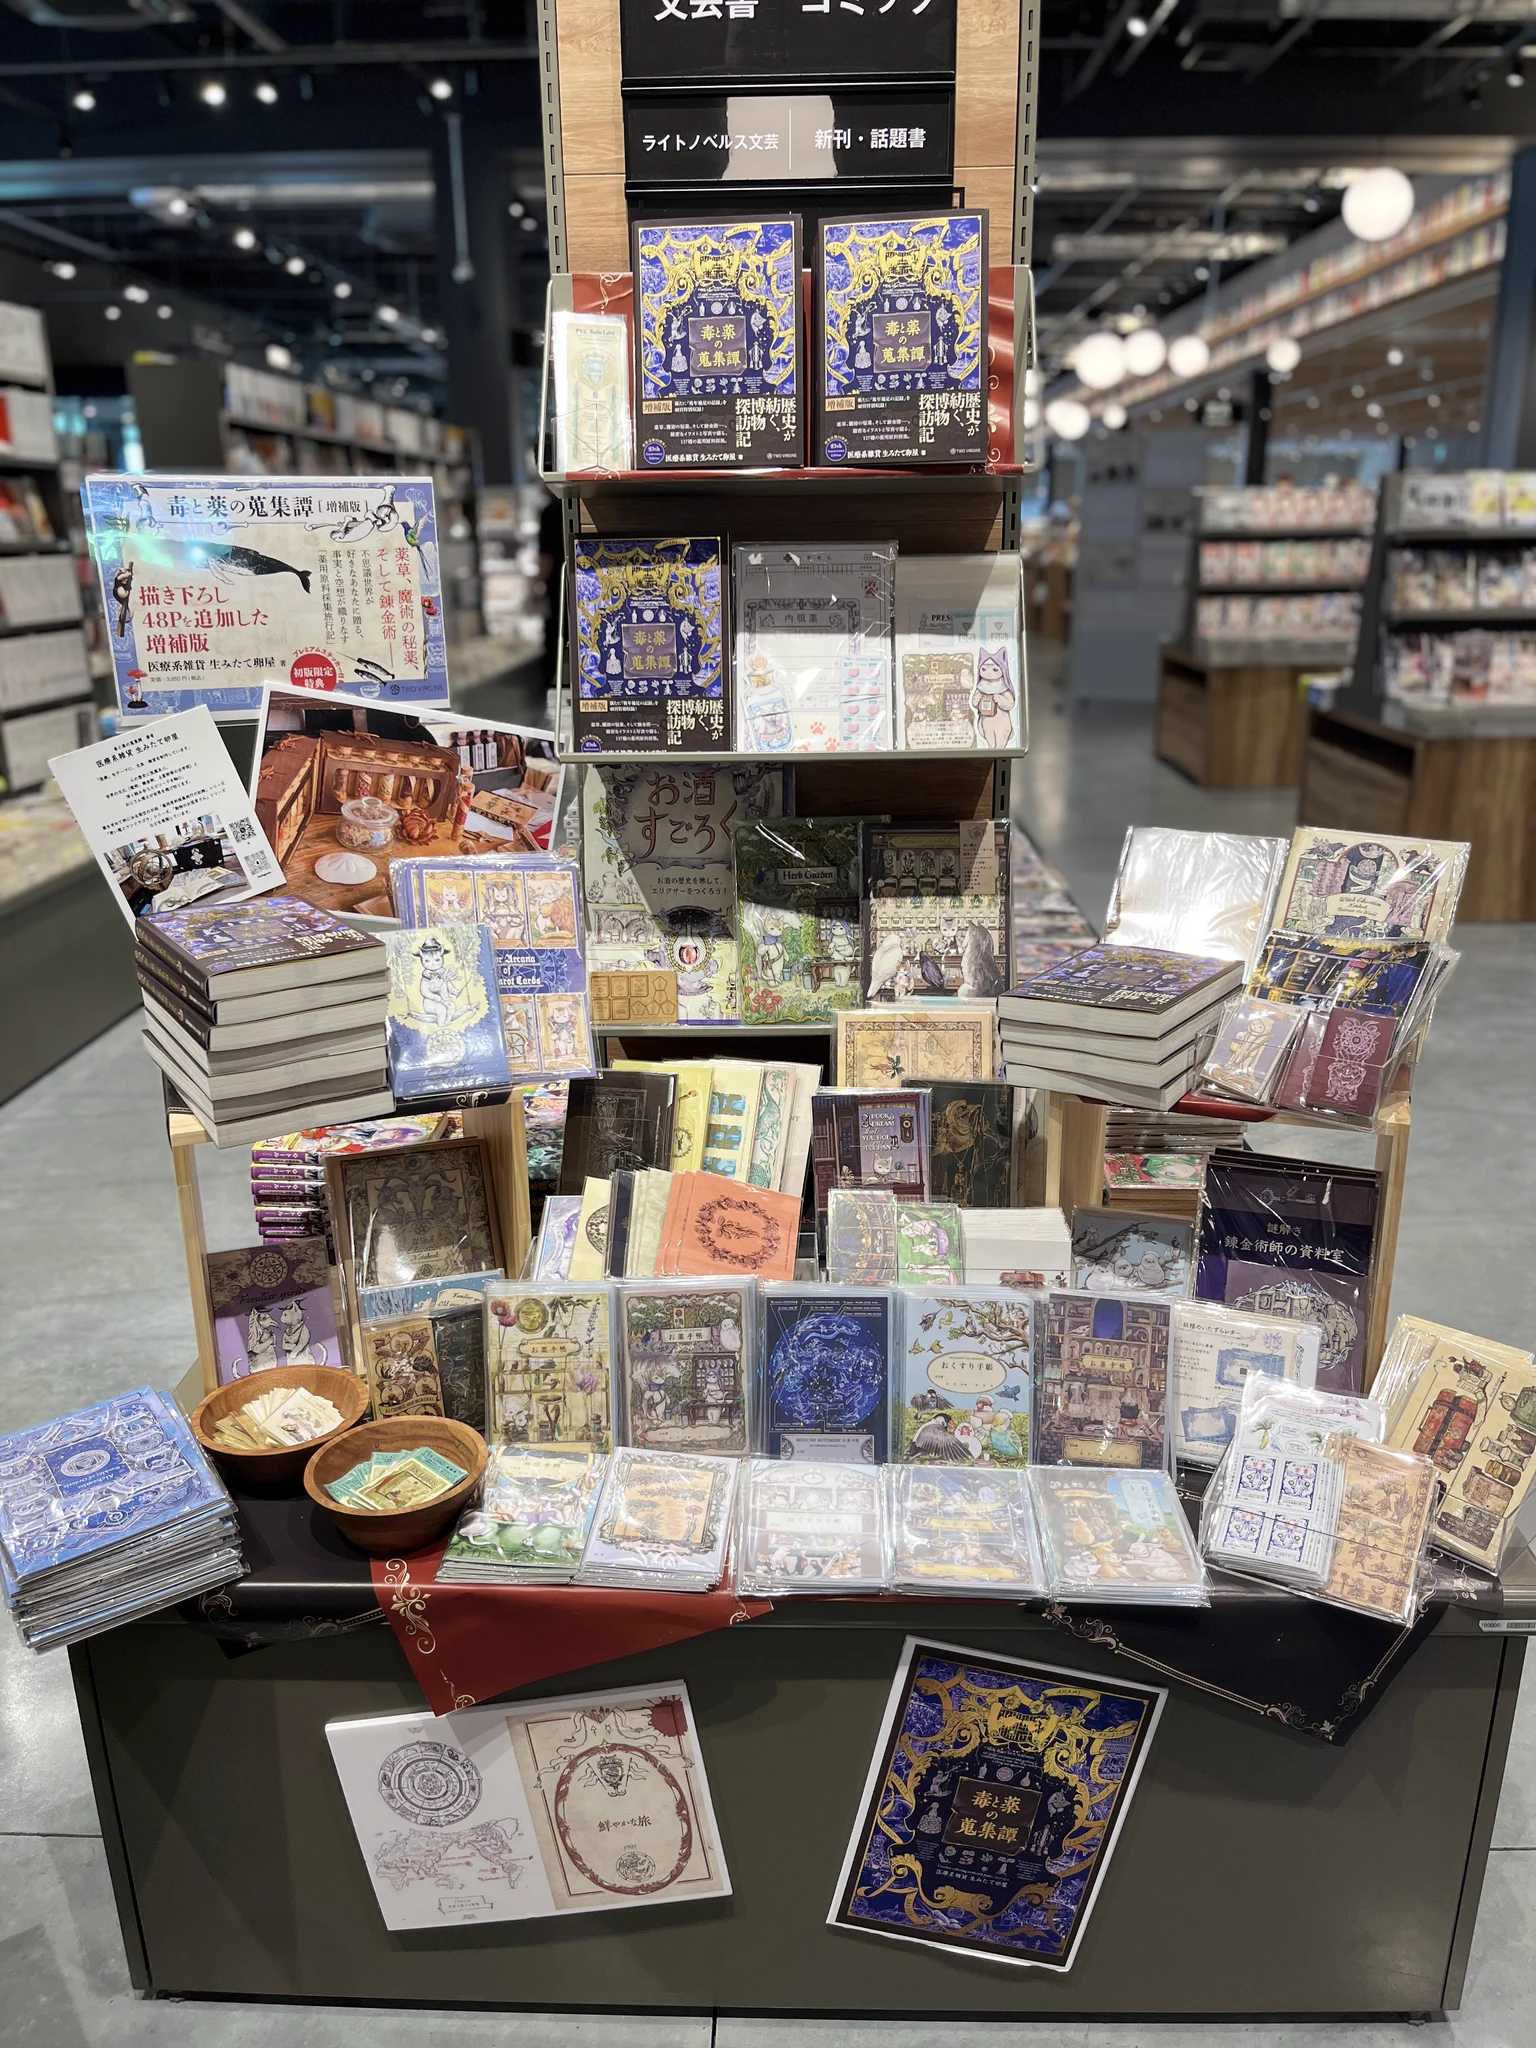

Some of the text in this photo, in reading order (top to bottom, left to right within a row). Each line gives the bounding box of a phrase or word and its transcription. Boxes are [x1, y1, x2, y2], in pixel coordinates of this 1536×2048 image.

[642, 127, 927, 151] ライトノベルス文芸 新刊・話題書
[701, 323, 736, 340] 毒と薬
[885, 319, 921, 337] 毒と薬
[714, 340, 722, 348] の
[899, 335, 907, 344] の
[643, 401, 671, 414] 増補版
[826, 397, 854, 410] 増補版
[935, 394, 950, 427] 博物
[751, 398, 766, 432] 博物
[780, 397, 797, 442] 歴史が
[919, 394, 935, 443] 探訪記
[965, 392, 981, 437] 歴史が
[735, 399, 752, 448] 探訪記
[167, 494, 315, 518] 毒と薬の蒐集譚
[361, 549, 374, 605] 不思議世界が
[140, 585, 229, 606] 描き下ろし
[318, 549, 336, 645] 「薬用原料採集旅行記」
[333, 550, 349, 644] 事実と空想が織りなす
[346, 549, 364, 638] 好きなあなたに贈る、
[395, 546, 419, 670] 薬草、魔術の秘薬、
[142, 608, 269, 629] 48Pを追加した
[785, 613, 818, 623] 内服薬
[146, 632, 210, 654] 増補版
[633, 630, 667, 645] 毒と薬
[646, 645, 655, 653] の
[148, 660, 205, 672] 医療系雑貨
[209, 657, 275, 670] 生みたて卵屋
[294, 667, 334, 678] 初版限定
[304, 678, 325, 688] 特典
[418, 684, 443, 692] VIRGINS
[581, 701, 607, 711] 増補版
[666, 700, 682, 745] 探訪記
[681, 700, 695, 730] 博物
[710, 700, 724, 740] 歴史が
[95, 732, 179, 768] 医療系雑貨 生みたて卵屋
[646, 771, 718, 806] お酒
[634, 800, 738, 859] すごろく
[657, 876, 724, 886] お酒の歴史を旅して、
[783, 870, 833, 880] Herb Garden
[1339, 895, 1355, 903] Witch
[504, 953, 536, 963] Arcana
[503, 965, 511, 976] of
[498, 975, 541, 986] arot Cards
[1267, 1222, 1302, 1236] 謎解き
[411, 1235, 434, 1245] Witch
[410, 1252, 439, 1261] Notebook
[1224, 1236, 1344, 1263] 錬金術師の資料室
[238, 1287, 306, 1305] Familiar spirits
[669, 1332, 705, 1342] お薬手帳
[1182, 1322, 1241, 1336] 妖精のいたずらレター
[531, 1346, 567, 1354] お薬手帳
[941, 1360, 994, 1372] おくすり手帳
[1090, 1359, 1128, 1371] お薬手帳
[77, 1473, 114, 1489] Alchemist
[970, 1789, 1022, 1814] 毒と薬
[598, 1815, 652, 1832] 鮮やかな旅
[985, 1810, 998, 1821] の
[954, 1817, 1019, 1843] 蒐集譚
